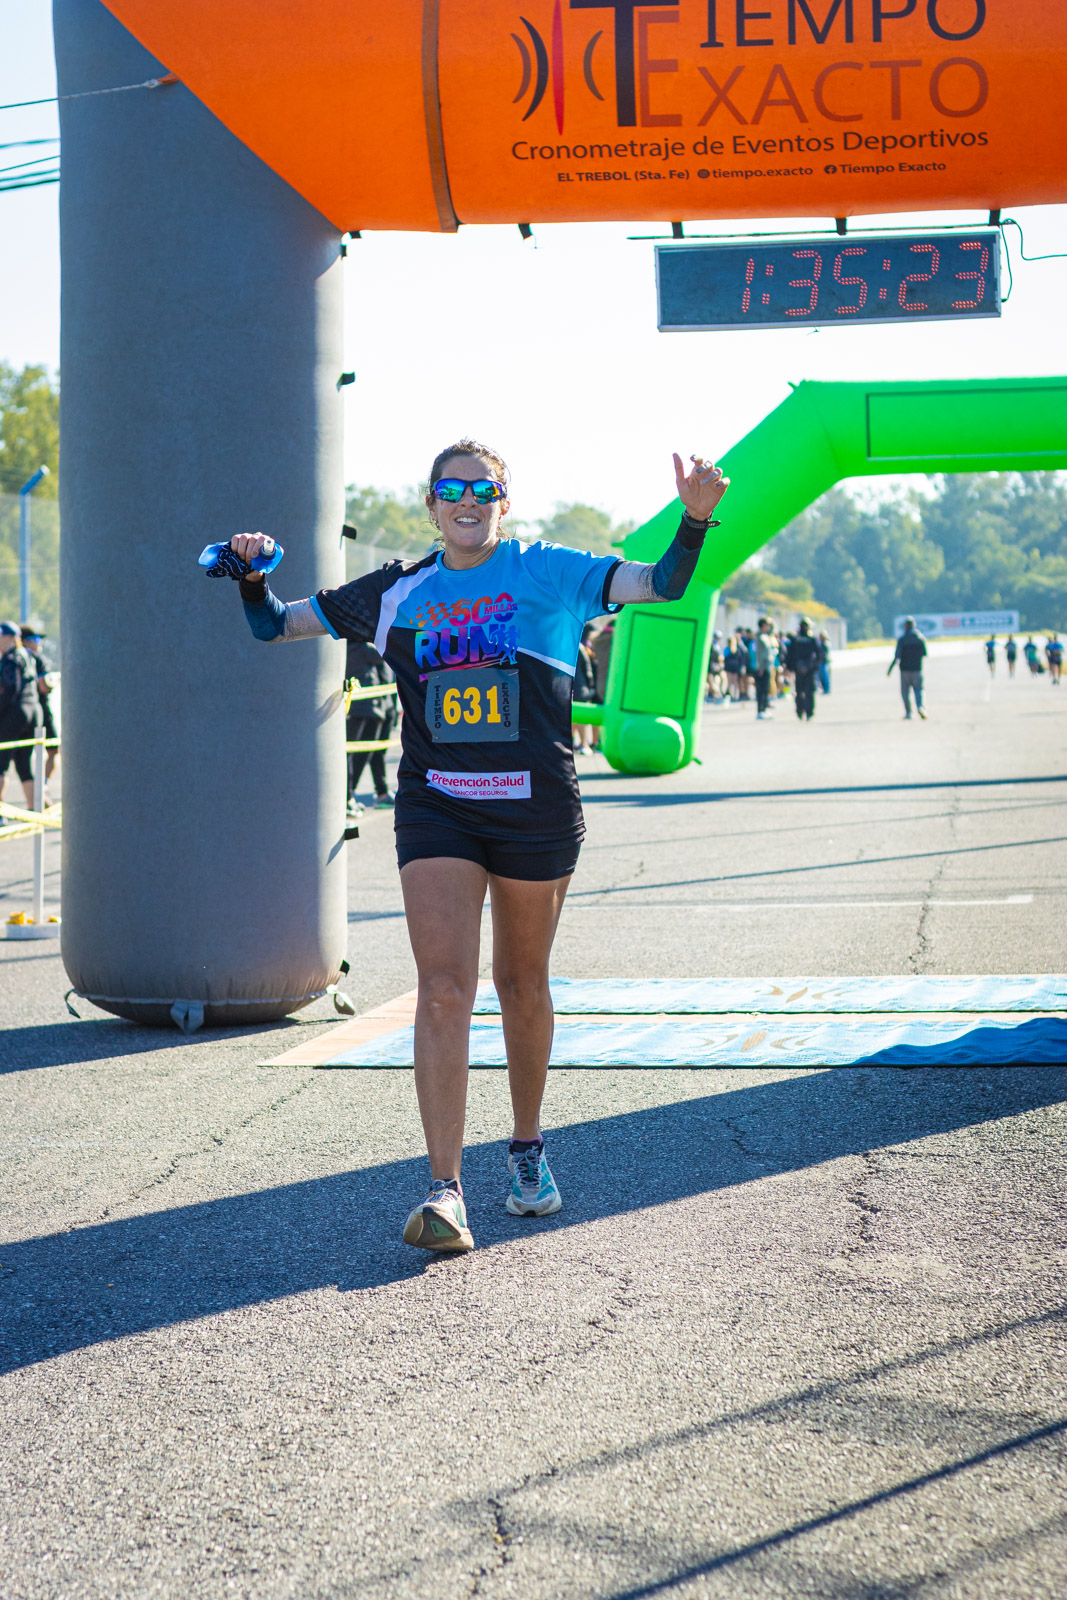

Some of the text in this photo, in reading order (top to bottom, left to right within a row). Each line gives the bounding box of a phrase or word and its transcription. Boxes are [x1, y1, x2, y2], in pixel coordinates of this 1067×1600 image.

[511, 128, 989, 161] Cronometraje de Eventos Deportivos
[557, 161, 947, 182] EL TREBOL (Sta. Fe) tiempo.exacto Tiempo Exacto
[741, 242, 989, 317] 1:35:23
[484, 603, 518, 614] MILLAS
[414, 623, 501, 669] RUN
[434, 685, 442, 729] TIEMPO
[443, 685, 502, 725] 631
[501, 682, 511, 728] EXACTO
[431, 773, 525, 788] Prevención Salud
